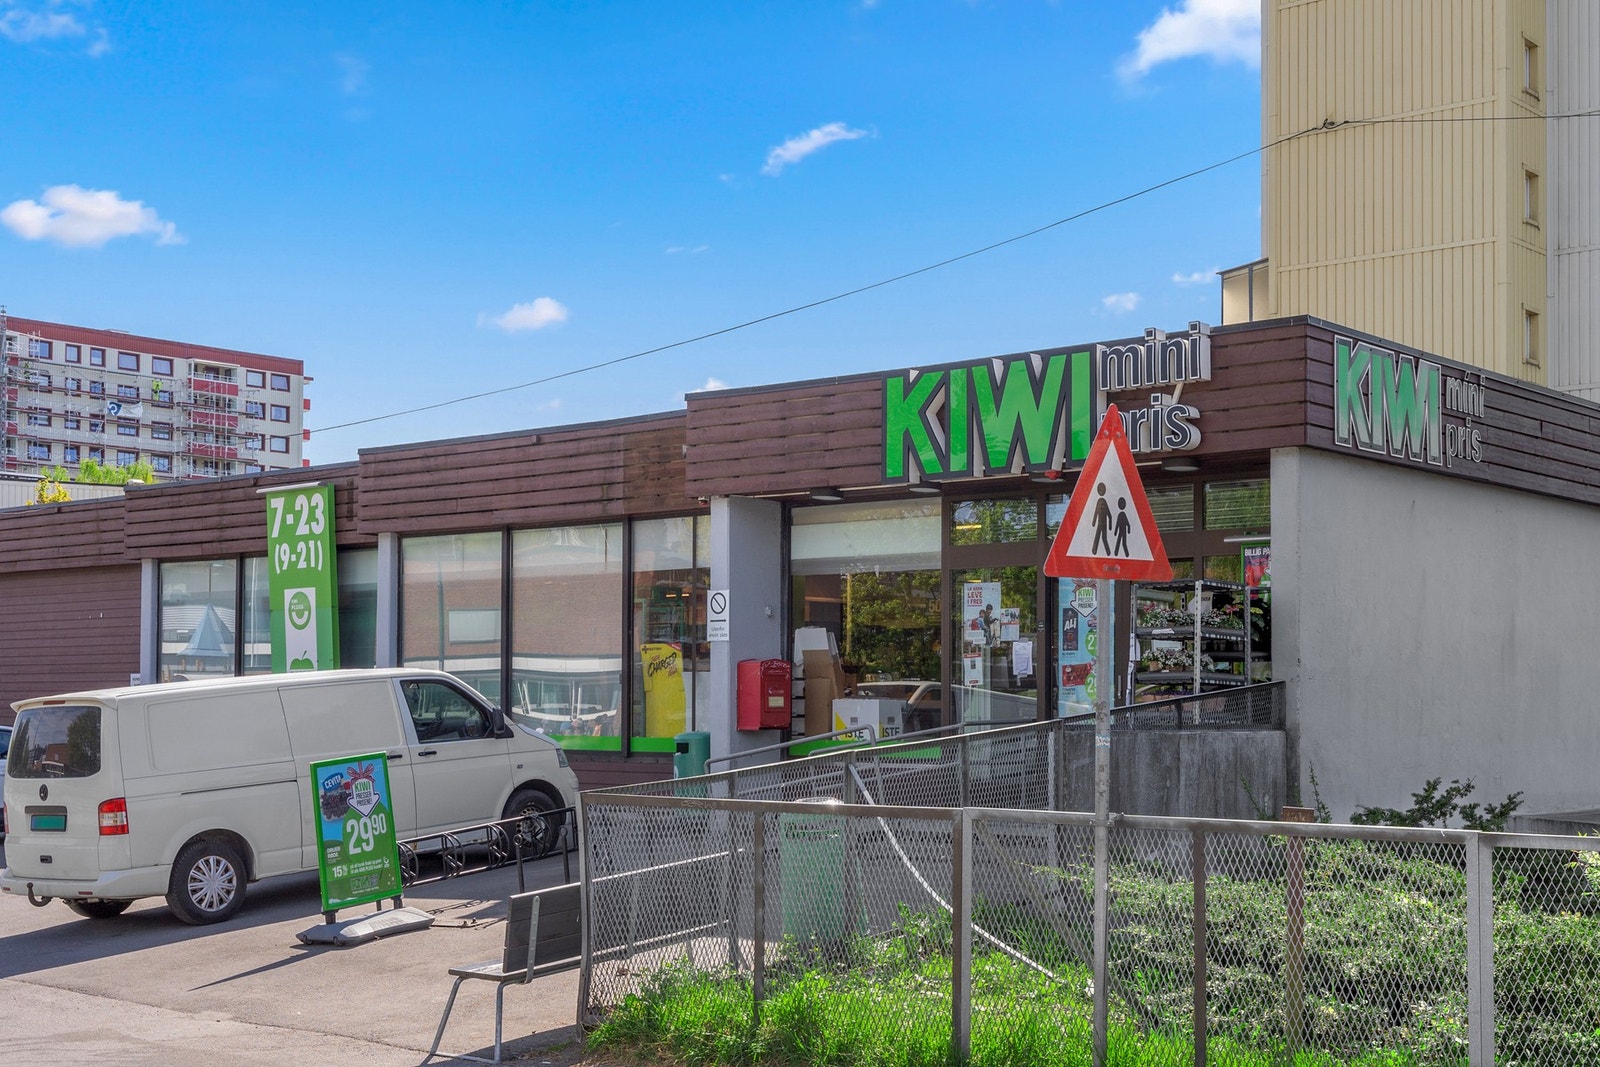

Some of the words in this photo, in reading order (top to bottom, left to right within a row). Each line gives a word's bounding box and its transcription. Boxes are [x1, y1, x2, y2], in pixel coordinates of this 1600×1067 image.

[1100, 321, 1209, 391] mini
[884, 348, 1094, 480] KIWI
[1335, 335, 1442, 466] KIWI
[1446, 371, 1486, 418] mini
[1101, 393, 1193, 452] ris
[1446, 417, 1482, 468] pris
[270, 492, 325, 538] 7-23
[274, 540, 323, 575] (9-21)
[1077, 588, 1094, 597] KIWI
[354, 780, 371, 793] KIWI
[346, 816, 375, 855] 29
[371, 812, 387, 836] 90
